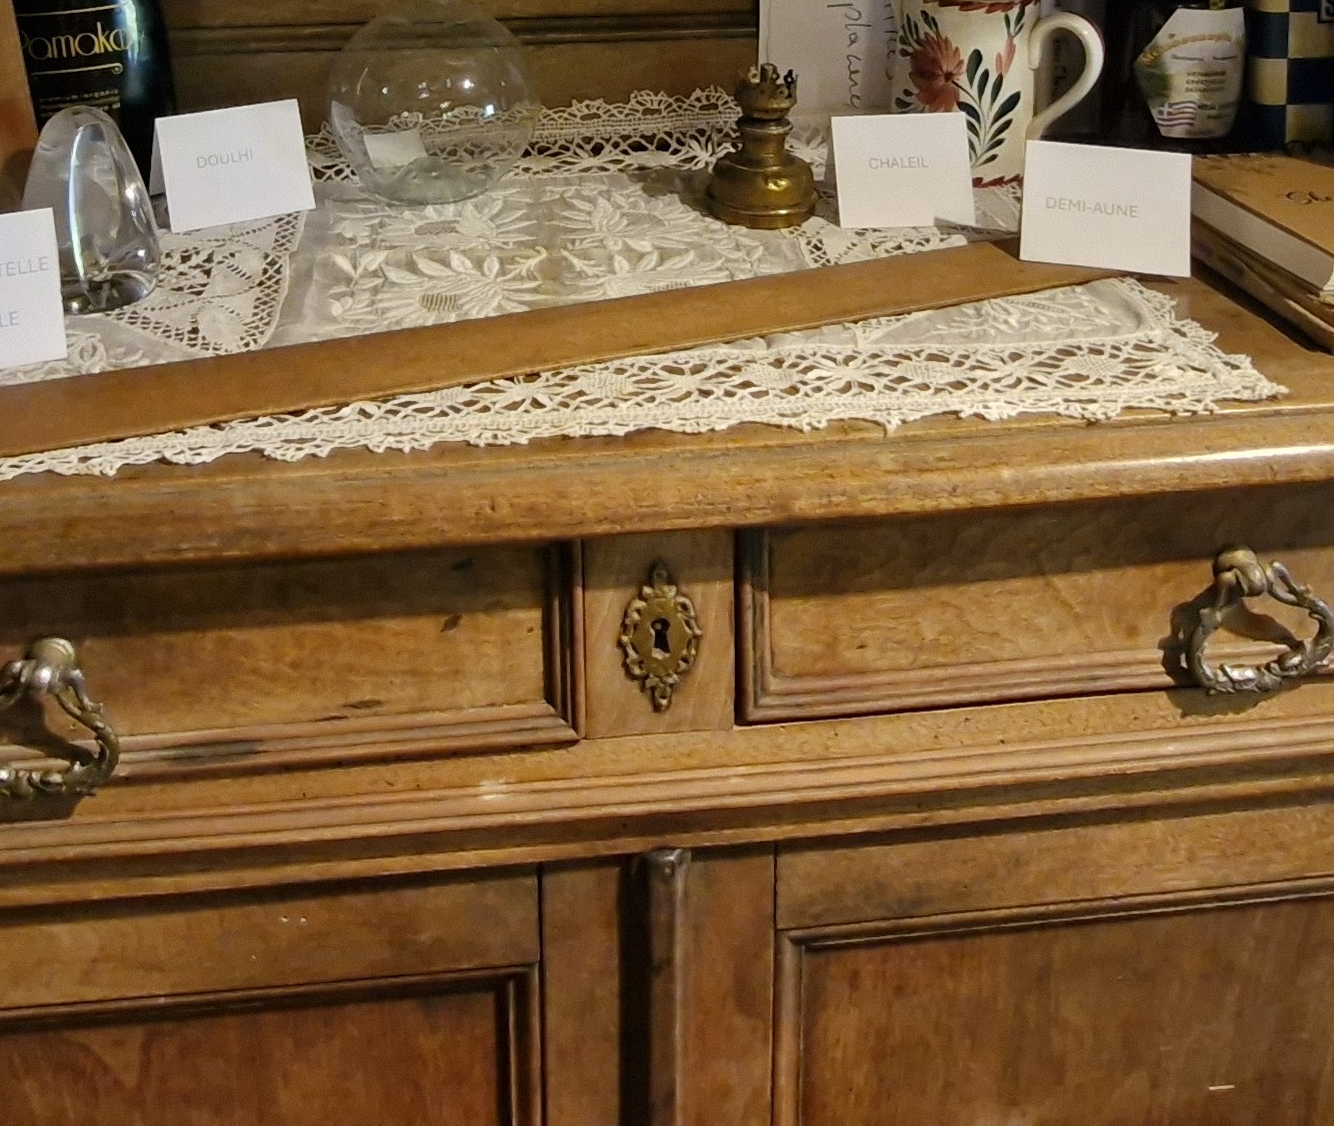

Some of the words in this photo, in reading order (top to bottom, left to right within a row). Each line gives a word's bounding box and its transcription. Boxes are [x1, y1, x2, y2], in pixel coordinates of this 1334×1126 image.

[196, 149, 254, 169] DOULHI
[868, 155, 930, 170] CHALEIL
[1045, 196, 1140, 219] DEMI-AUNE
